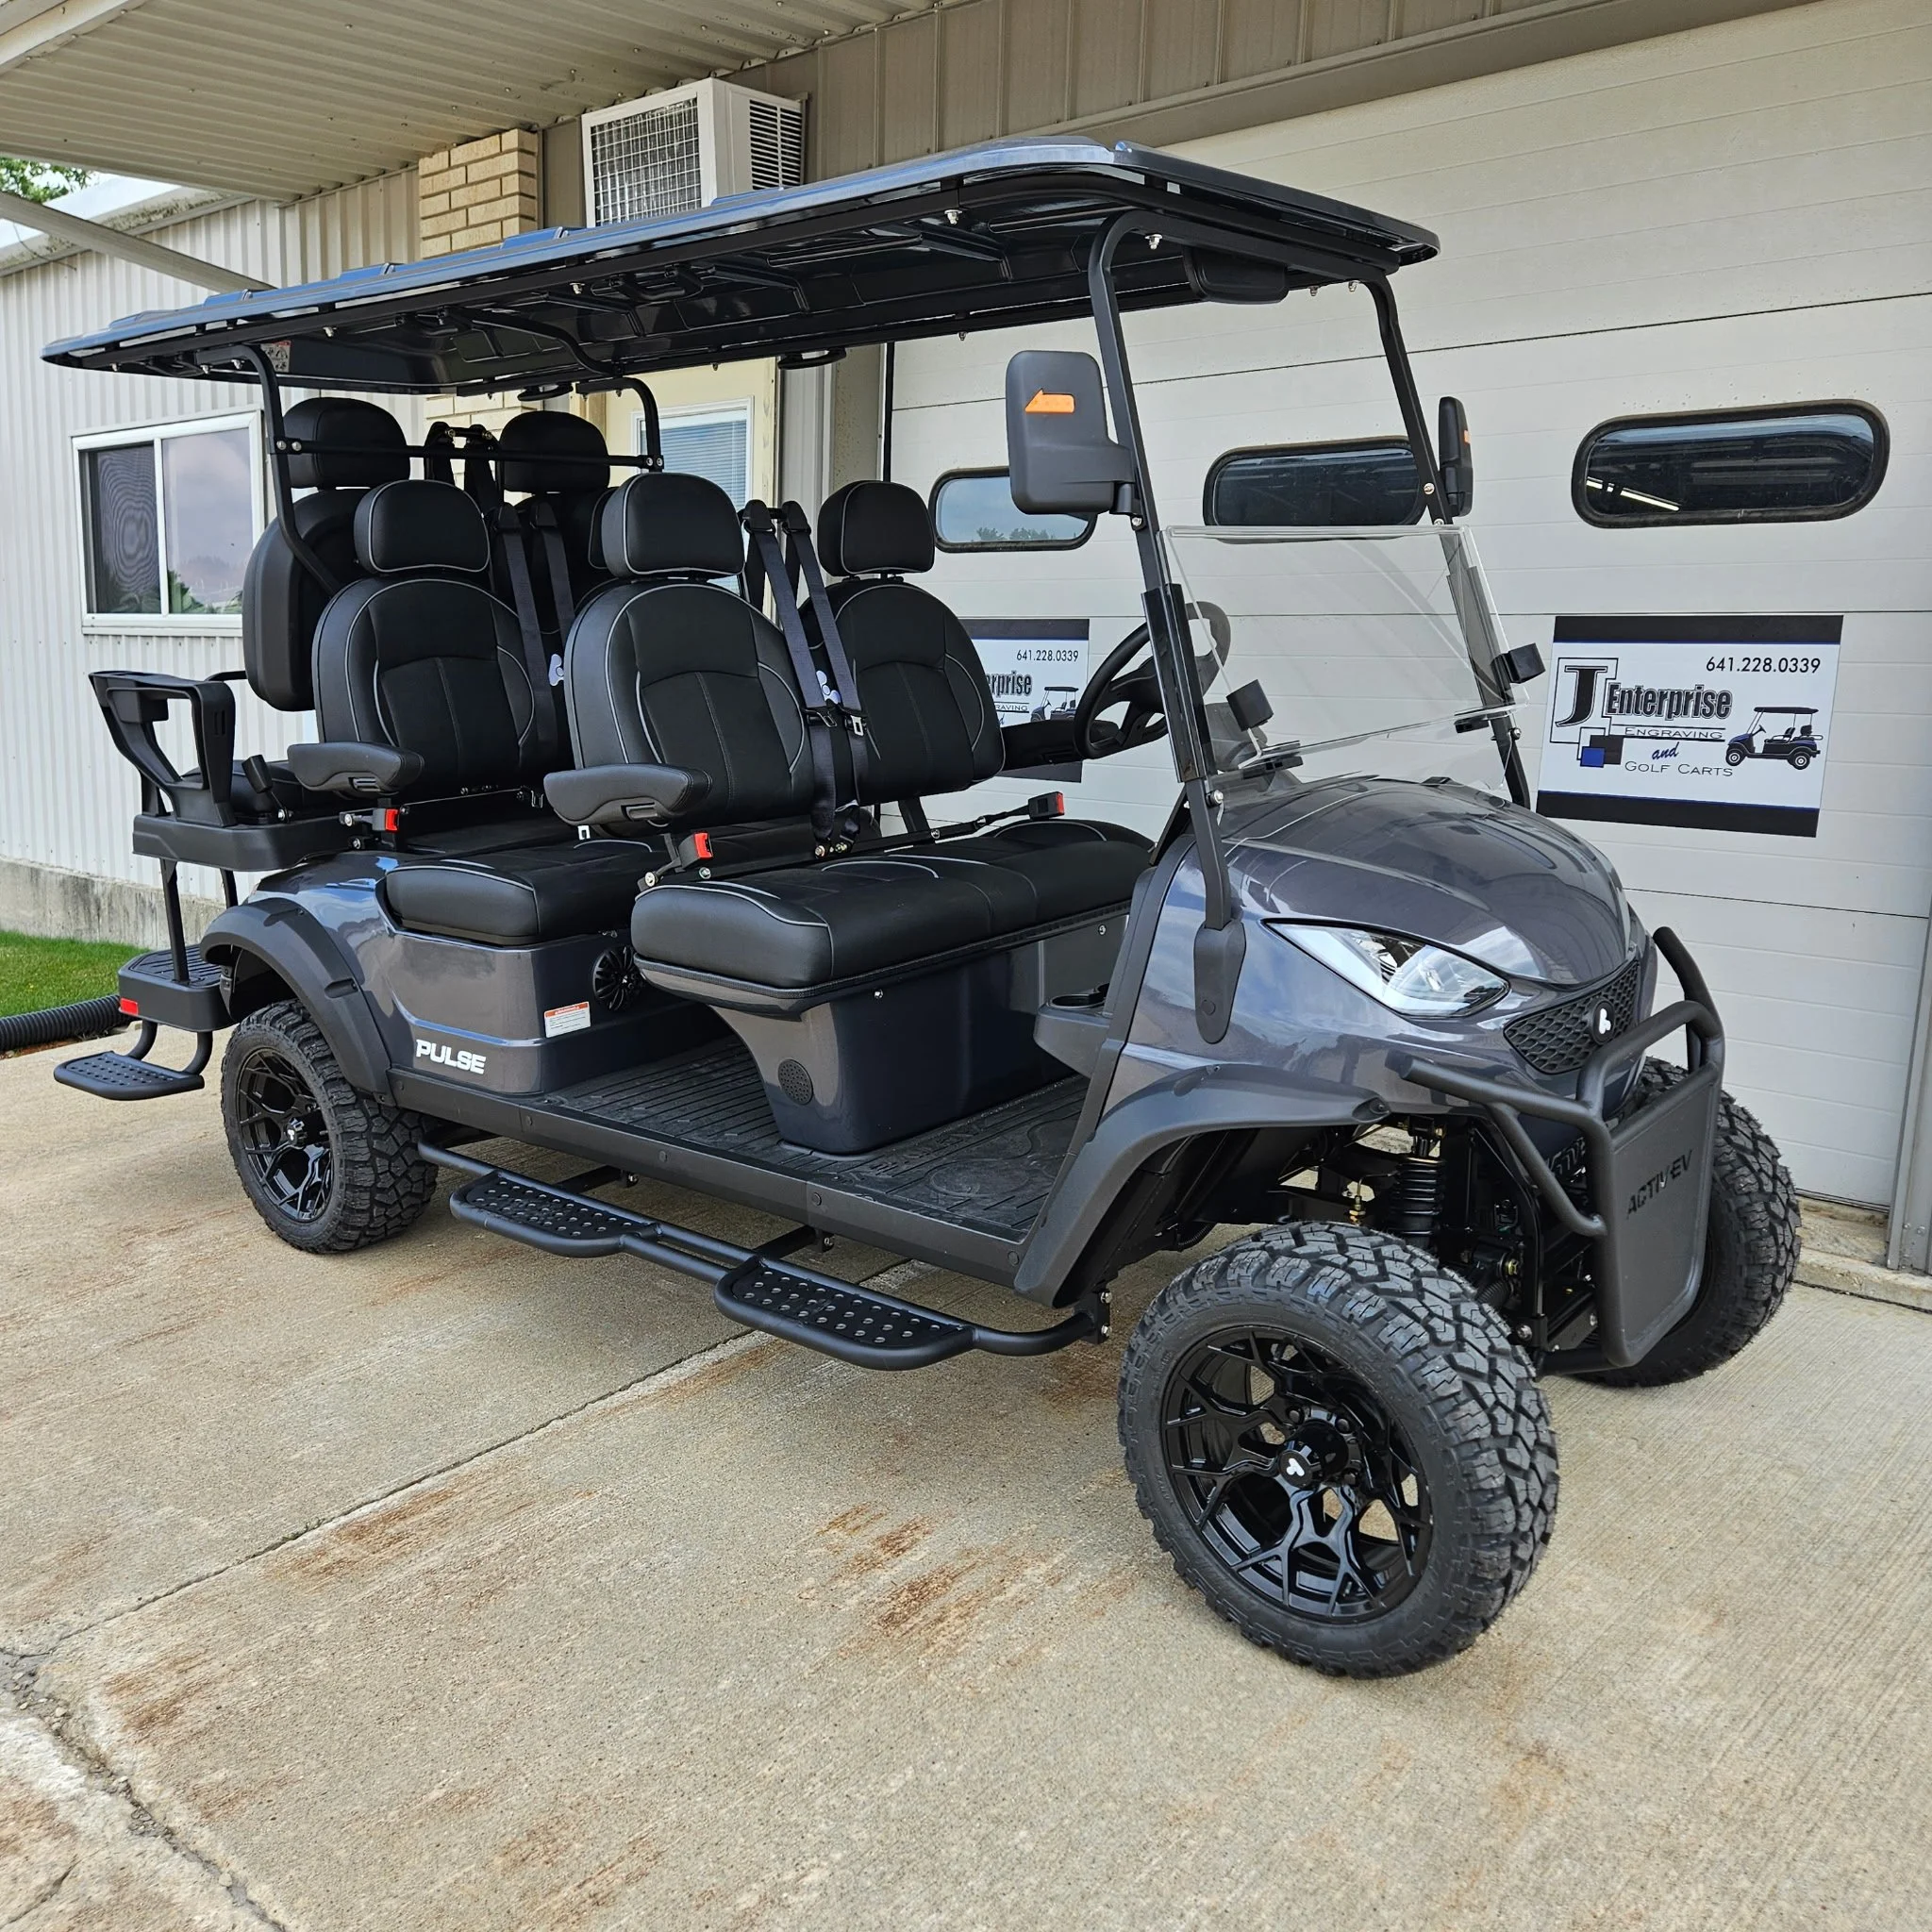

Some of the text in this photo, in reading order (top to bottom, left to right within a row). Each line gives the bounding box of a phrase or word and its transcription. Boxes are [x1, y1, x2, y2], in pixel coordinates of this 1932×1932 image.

[1016, 649, 1079, 662] 641.228.0339
[1706, 657, 1822, 674] 641.228.0339
[1607, 683, 1733, 721] Enterprise
[1624, 726, 1723, 740] ENGRAVING
[1651, 741, 1680, 760] and
[1624, 760, 1734, 777] GOLF CARTS
[415, 1039, 487, 1074] PULSE
